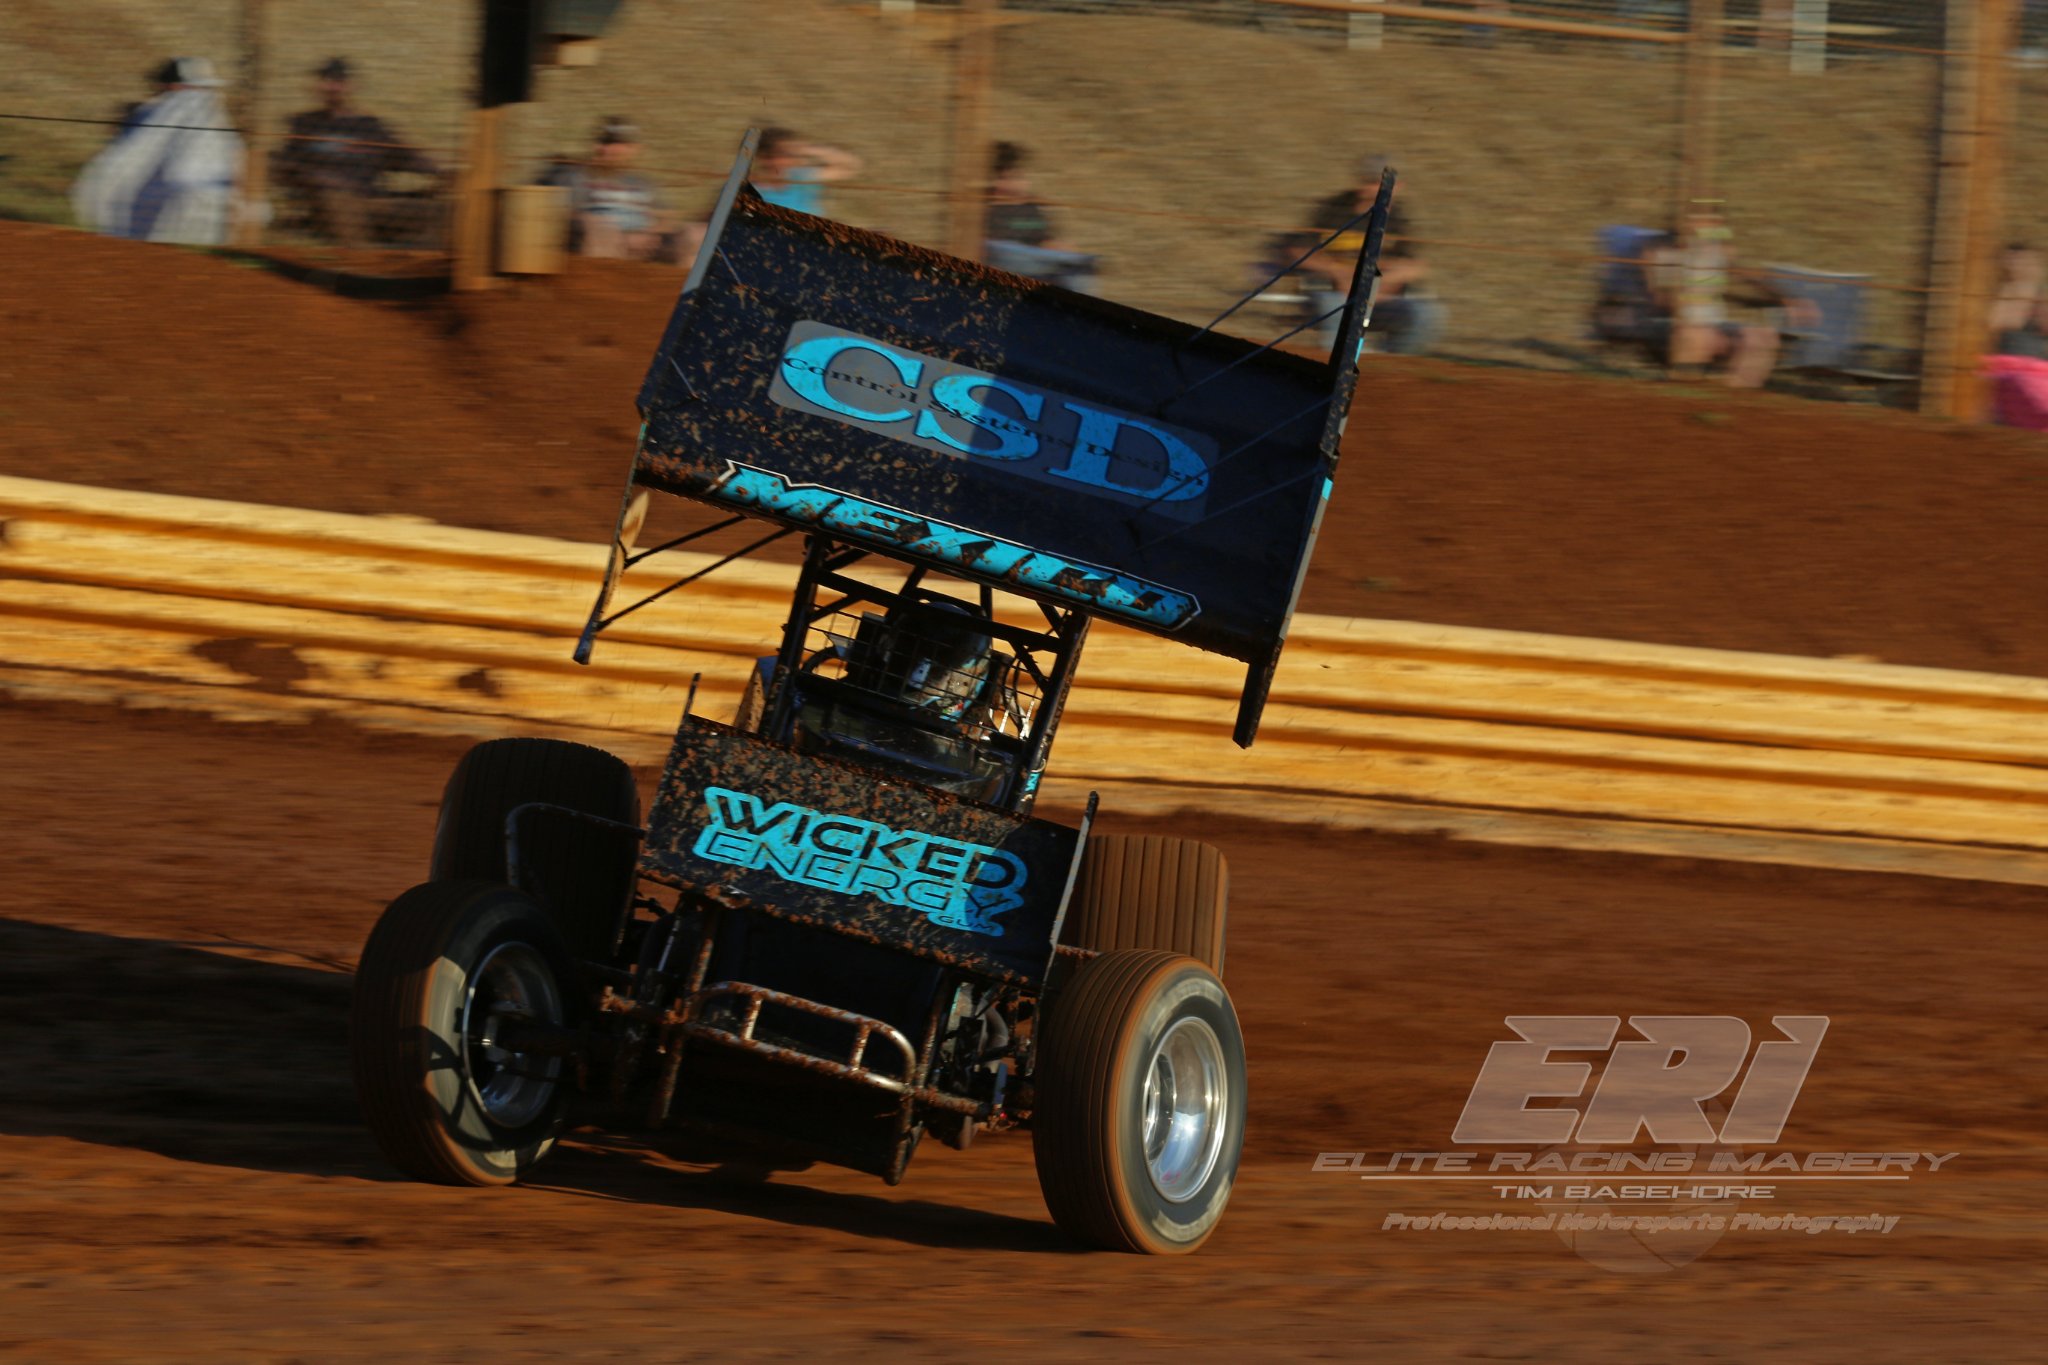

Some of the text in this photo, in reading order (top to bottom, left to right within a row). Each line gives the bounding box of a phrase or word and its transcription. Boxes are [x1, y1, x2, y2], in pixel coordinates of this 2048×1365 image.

[780, 337, 1210, 502] CSD
[784, 357, 1204, 488] Control Systems Design
[707, 830, 1013, 919] ENERGY
[713, 796, 1016, 889] WICKED
[938, 915, 995, 931] GUM
